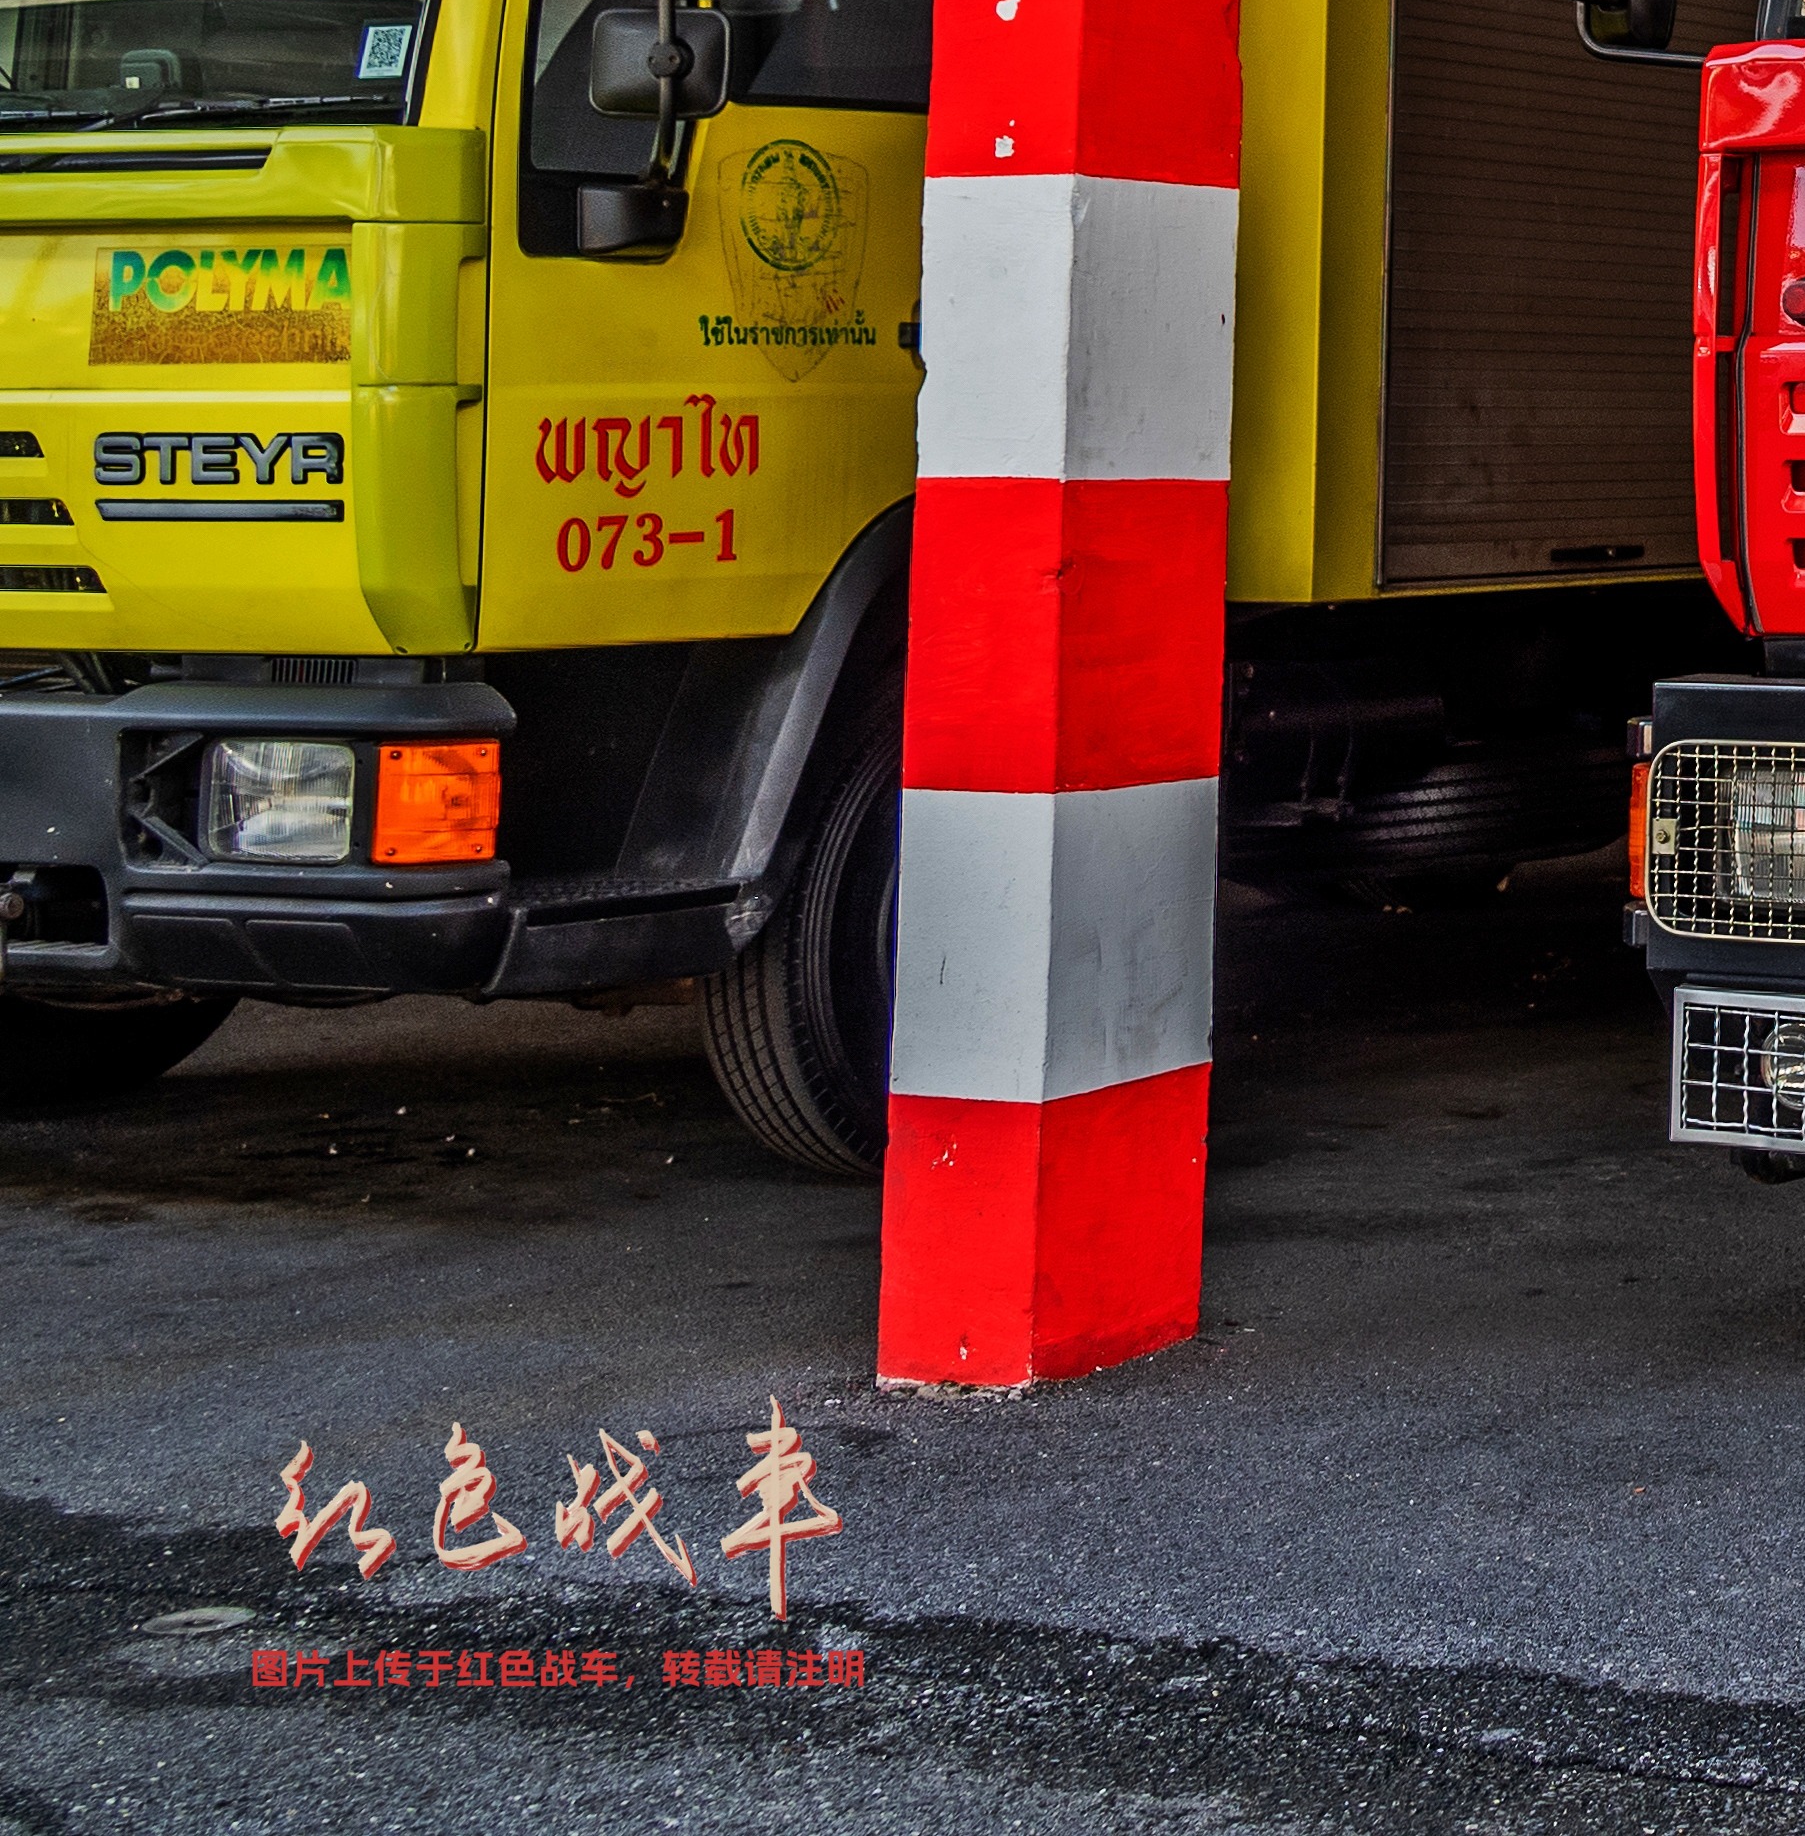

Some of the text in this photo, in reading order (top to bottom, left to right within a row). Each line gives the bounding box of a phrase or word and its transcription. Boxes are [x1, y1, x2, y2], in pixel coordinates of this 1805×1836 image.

[109, 247, 352, 313] POLYMA
[698, 309, 877, 346] ใช้ในราชการเท่านั้น
[94, 432, 345, 486] STEYR
[535, 393, 760, 499] พญาไท
[556, 508, 738, 573] 073-1
